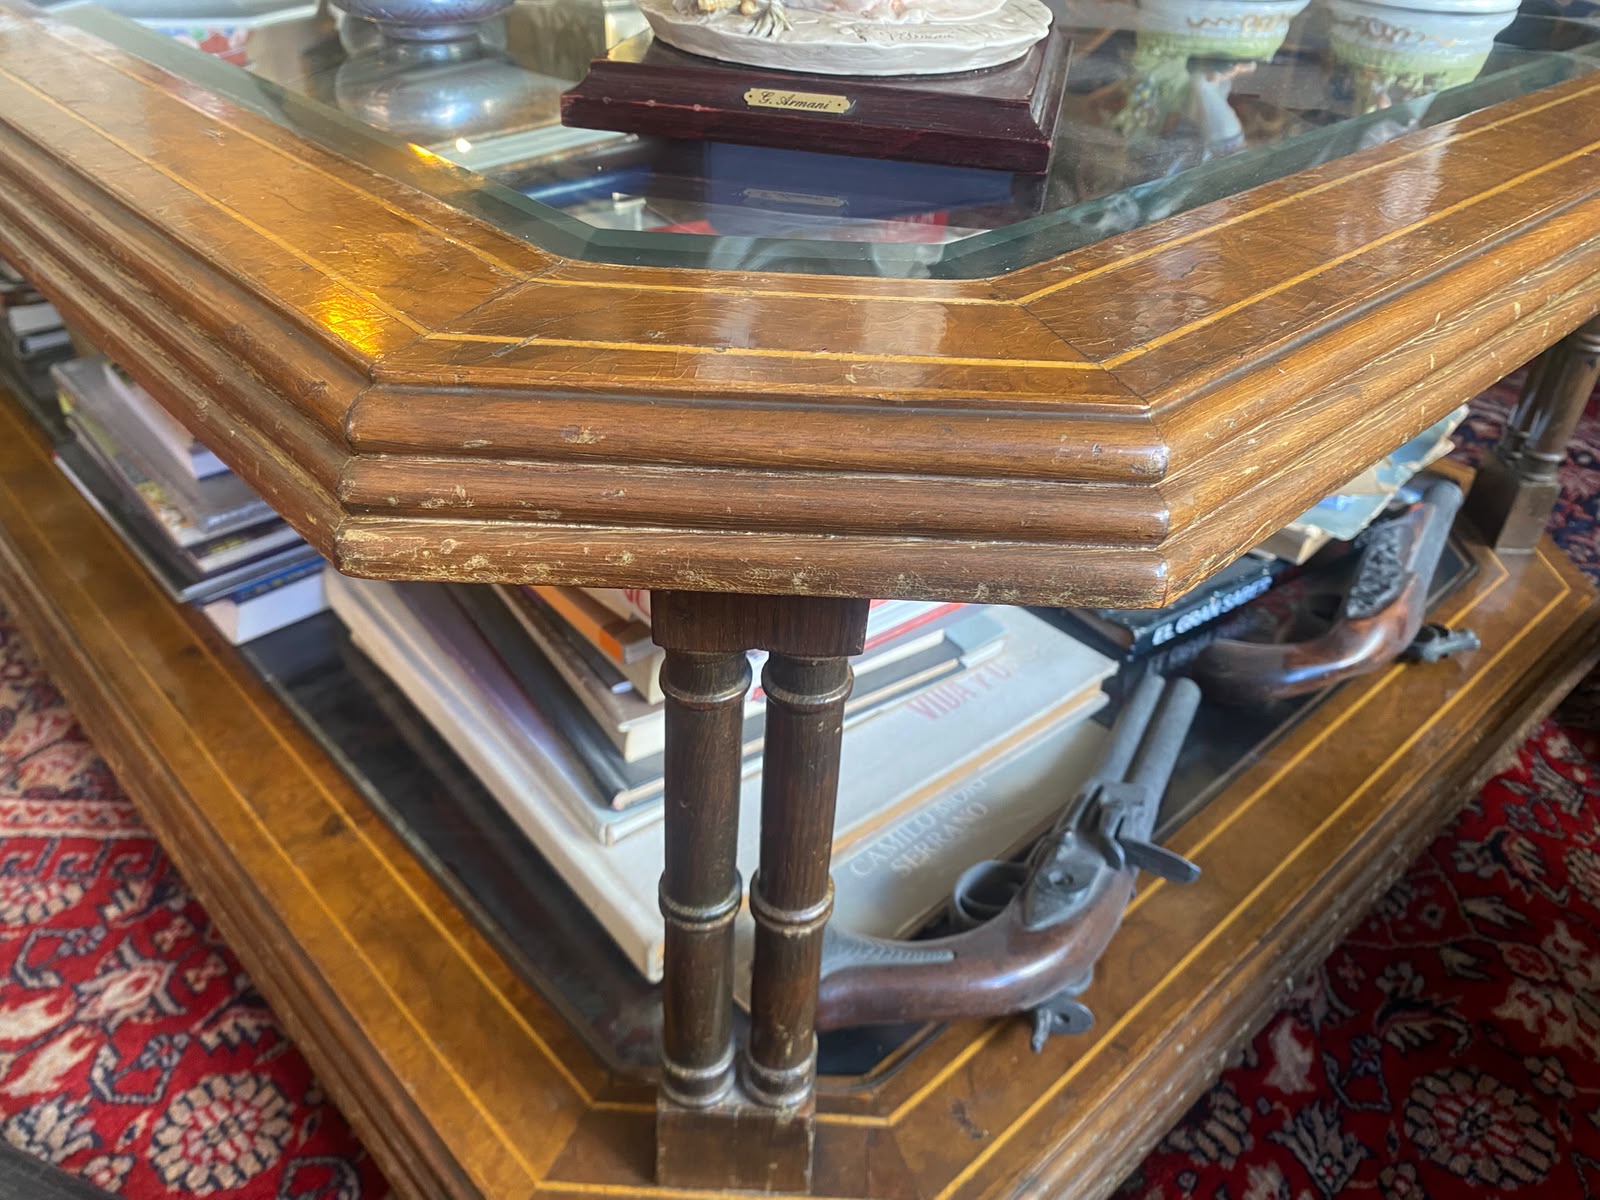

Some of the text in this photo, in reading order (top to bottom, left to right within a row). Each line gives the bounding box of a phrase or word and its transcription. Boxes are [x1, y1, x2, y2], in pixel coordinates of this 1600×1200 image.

[759, 91, 832, 110] G. Armani
[850, 810, 937, 877] CAMILO
[891, 802, 989, 876] SERRANO
